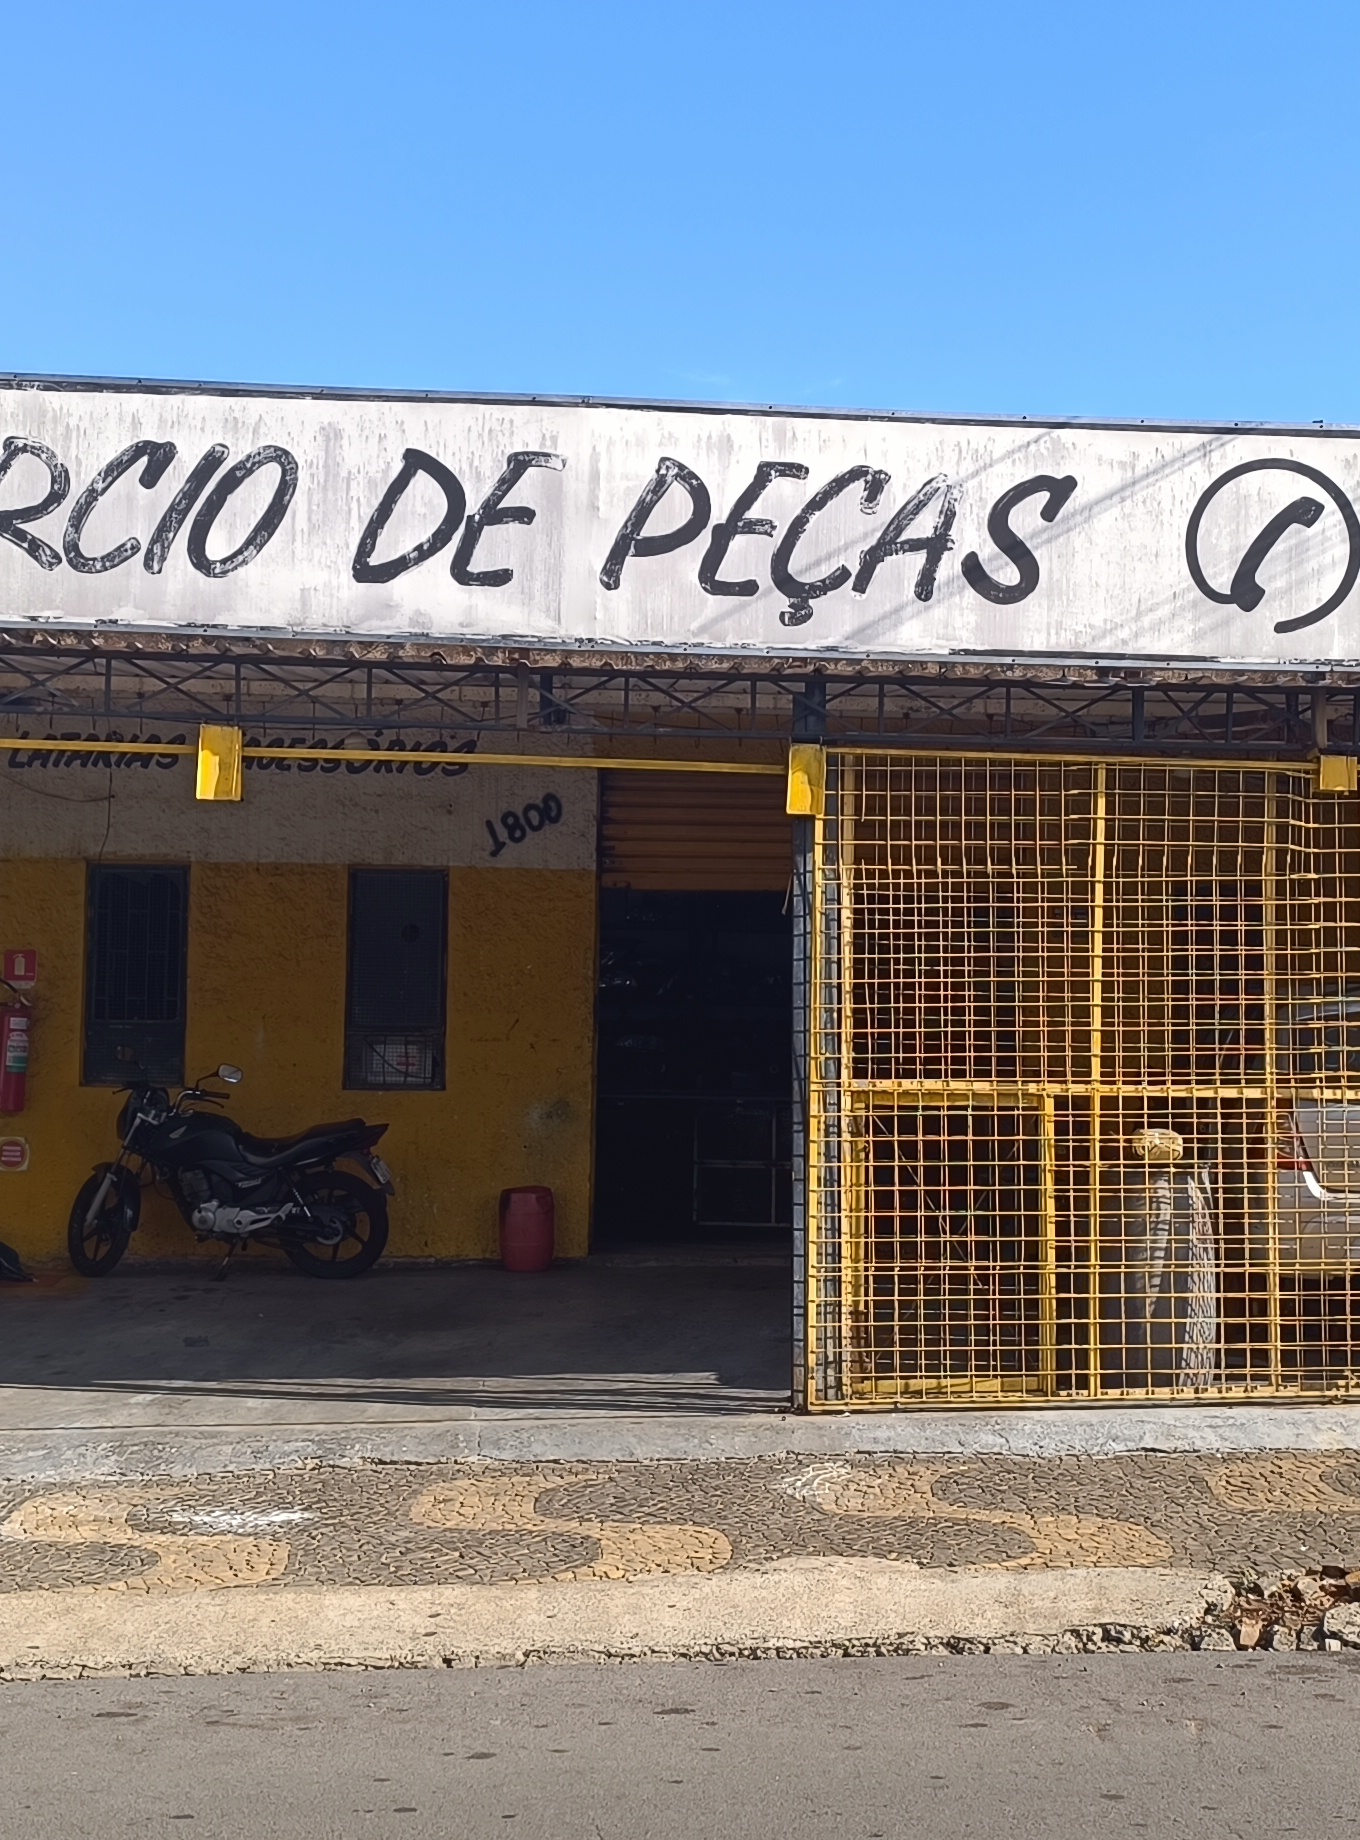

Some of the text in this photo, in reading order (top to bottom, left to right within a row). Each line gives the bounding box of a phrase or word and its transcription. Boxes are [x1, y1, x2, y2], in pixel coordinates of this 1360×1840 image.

[352, 447, 568, 587] DE
[599, 456, 1078, 627] PEÇAS
[7, 730, 187, 769] LATARIAS
[485, 792, 562, 857] 1800
